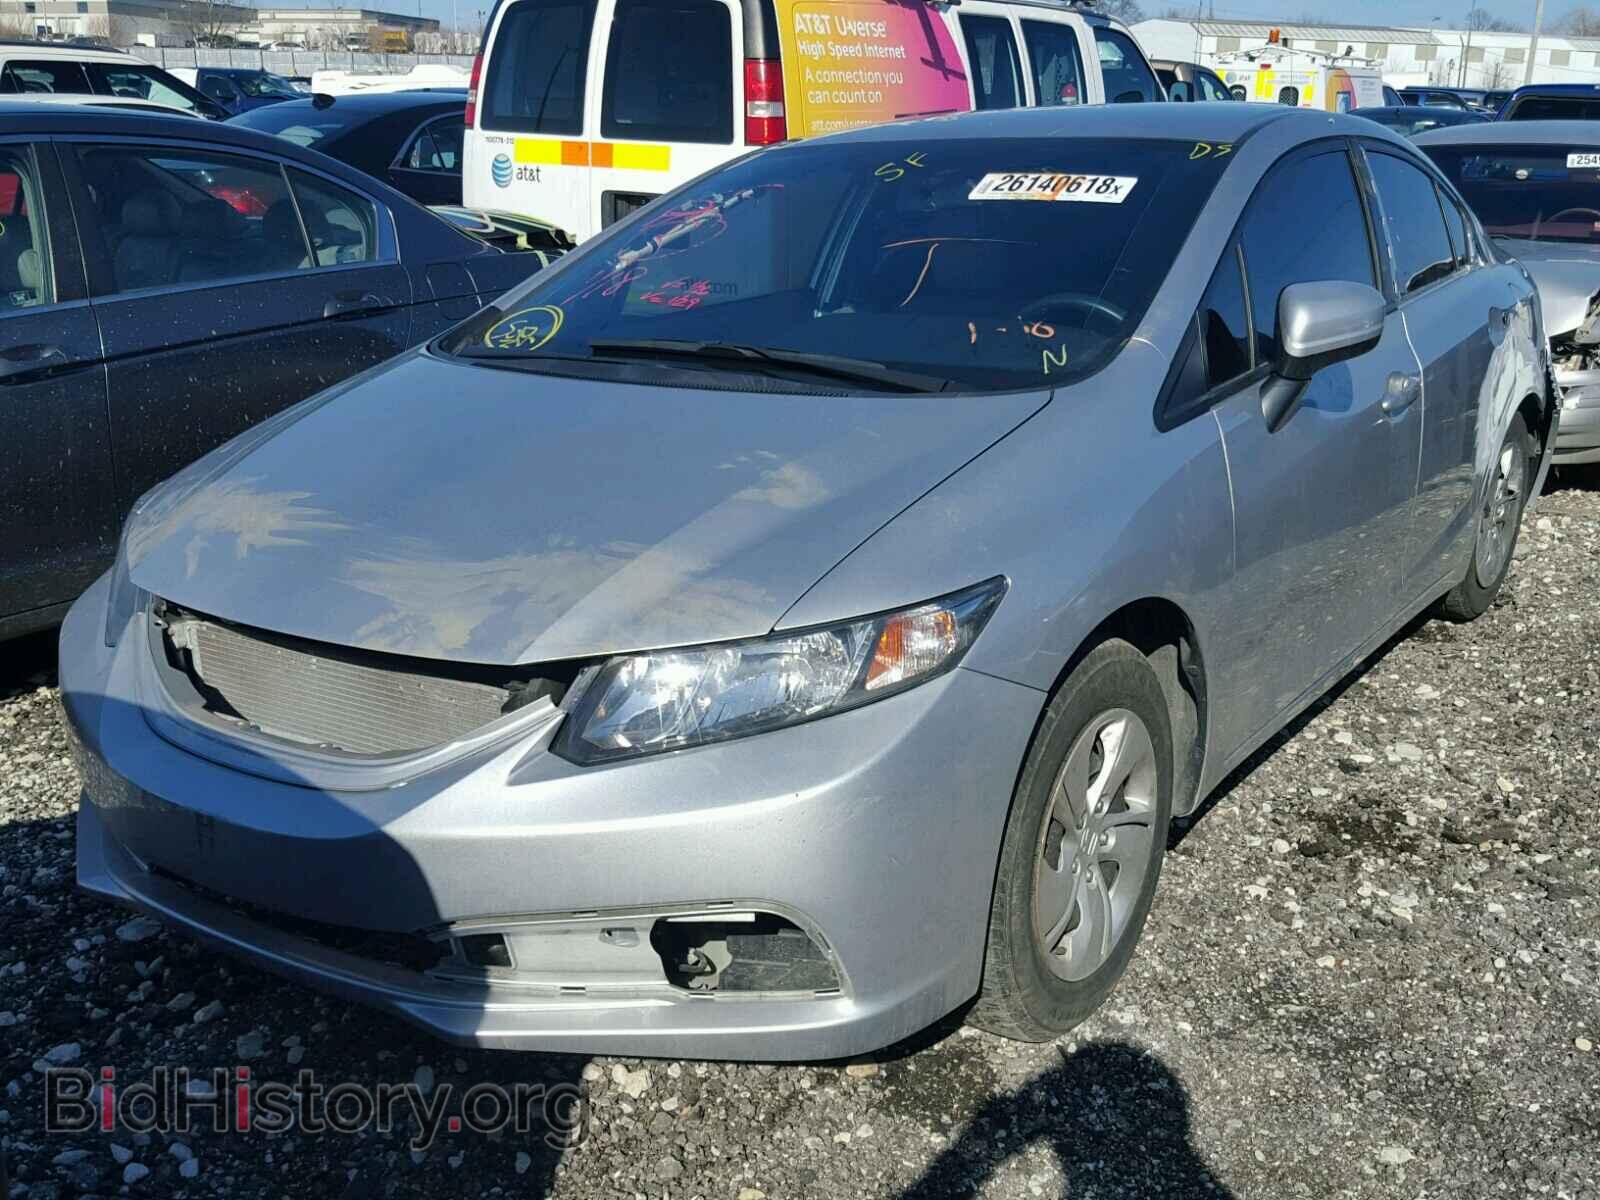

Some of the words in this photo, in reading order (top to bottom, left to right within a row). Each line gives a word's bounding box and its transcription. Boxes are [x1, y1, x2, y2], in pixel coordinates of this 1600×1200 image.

[795, 13, 832, 35] AT&T
[799, 40, 825, 60] High
[827, 41, 862, 60] Speed
[864, 42, 907, 59] Internet
[805, 67, 814, 84] A
[816, 69, 881, 84] connection
[884, 70, 904, 87] you
[807, 89, 831, 104] can
[832, 88, 867, 104] count
[868, 91, 882, 103] on
[1576, 155, 1600, 165] 254
[516, 165, 542, 183] at&t
